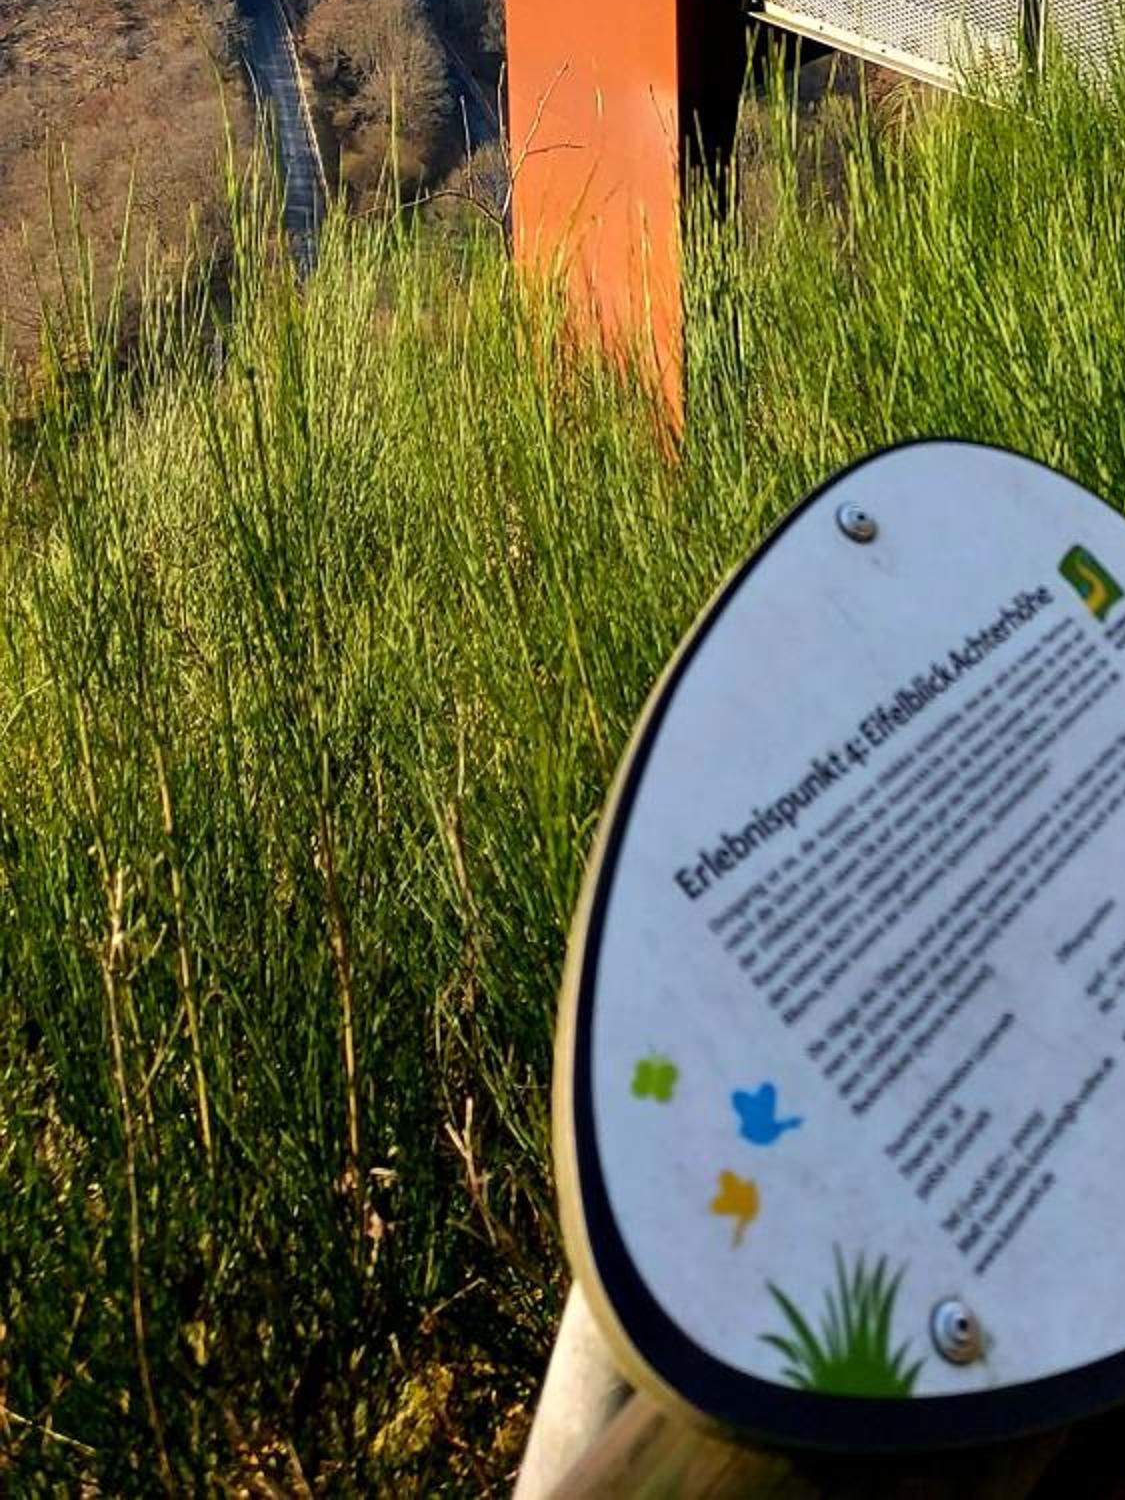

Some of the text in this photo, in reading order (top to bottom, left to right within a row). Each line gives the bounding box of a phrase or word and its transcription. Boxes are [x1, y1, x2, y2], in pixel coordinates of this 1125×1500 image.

[674, 752, 849, 900] Erlebnispunkt
[845, 737, 869, 767] 4:
[860, 661, 958, 746] Eifelblick
[948, 583, 1054, 678] Achterhöhe
